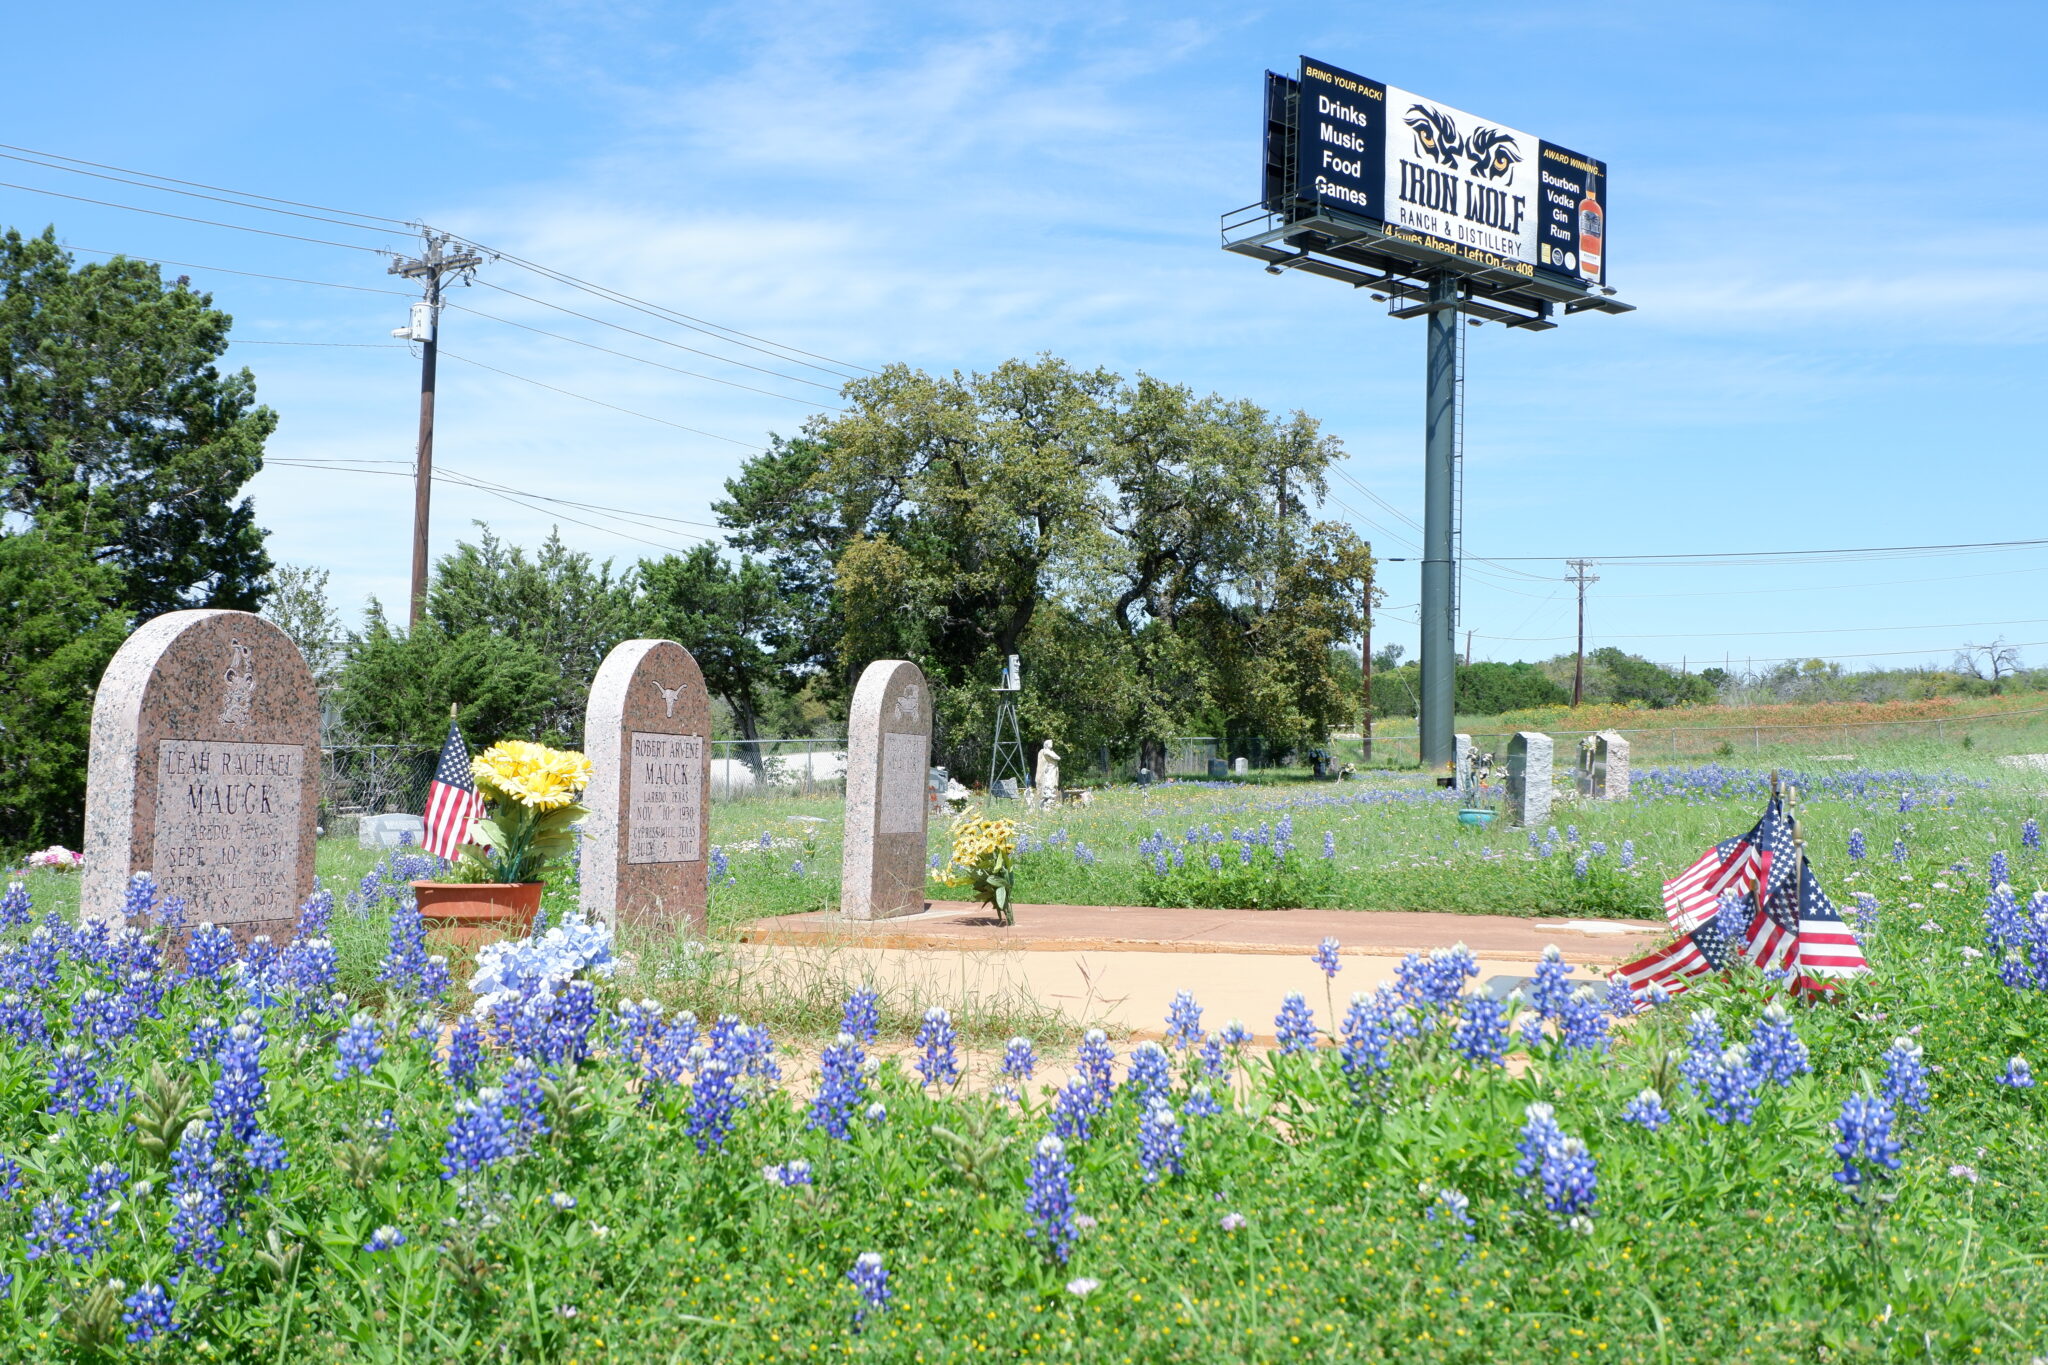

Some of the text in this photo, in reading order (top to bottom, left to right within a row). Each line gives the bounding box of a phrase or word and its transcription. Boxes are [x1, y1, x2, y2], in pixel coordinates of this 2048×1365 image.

[1306, 66, 1383, 101] BRING YOUR PACK!
[1319, 95, 1367, 127] Drinks
[1320, 122, 1364, 152] Music
[1323, 150, 1361, 178] Food
[1543, 149, 1605, 178] AWARD WINNING...
[1315, 175, 1368, 206] Games
[1542, 170, 1580, 194] Bourbon
[1399, 159, 1526, 235] IRON WOLF
[1547, 189, 1575, 209] Vodka
[1552, 208, 1569, 224] Gin
[1400, 207, 1522, 257] RANCH & DISTILLERY
[1550, 224, 1571, 241] Rum
[1385, 224, 1393, 236] 4
[1424, 235, 1457, 255] Ahead
[1464, 247, 1484, 263] Left
[1485, 253, 1500, 268] On
[1515, 262, 1534, 277] 408
[167, 750, 294, 777] LEAH RACHAEL
[635, 740, 667, 758] ROBERT
[645, 763, 689, 785] MAUCK
[186, 783, 273, 815] MAUCK
